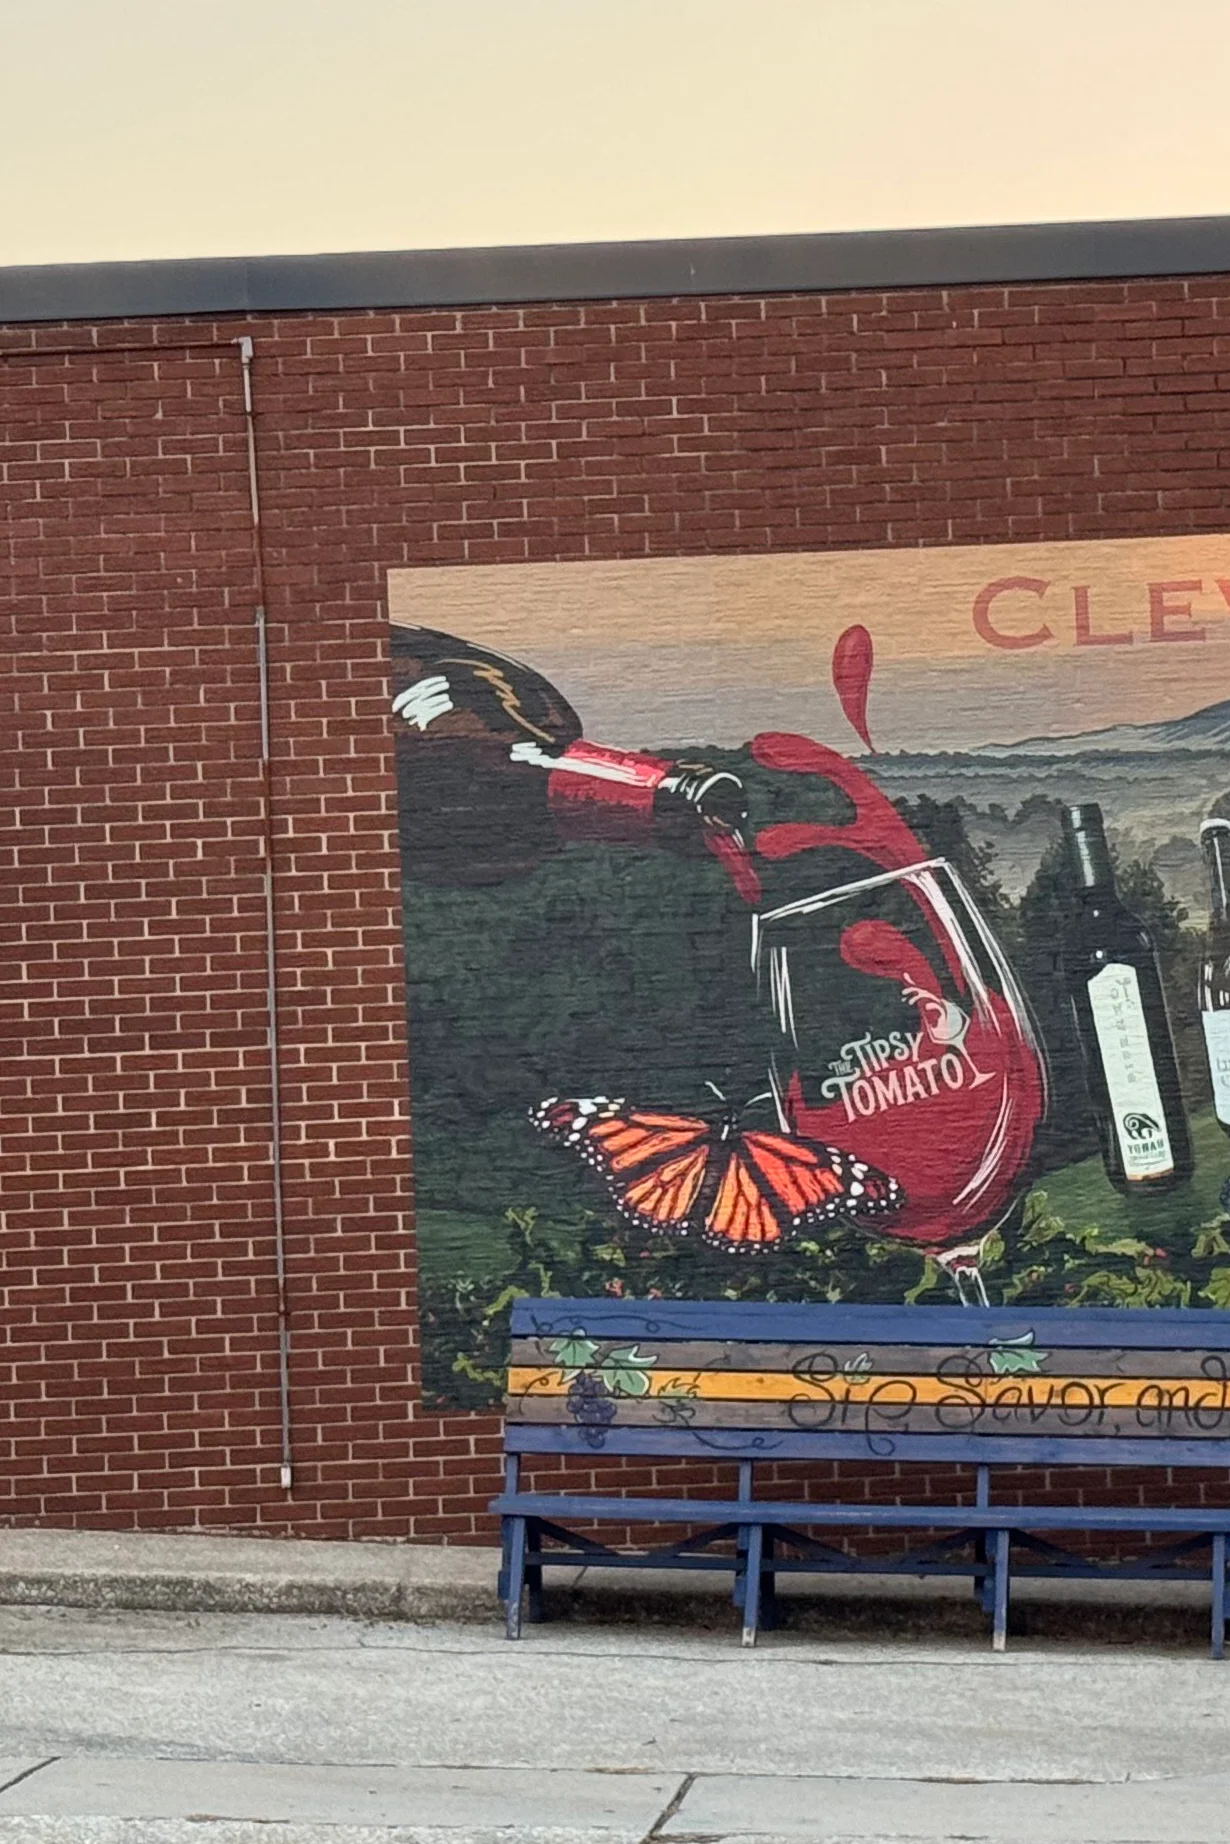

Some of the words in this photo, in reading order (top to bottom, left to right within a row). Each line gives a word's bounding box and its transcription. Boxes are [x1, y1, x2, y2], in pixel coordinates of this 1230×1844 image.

[820, 1052, 963, 1122] TOMATO
[840, 1031, 924, 1077] TIPSY
[934, 1354, 1122, 1435] Savor,
[1135, 1355, 1228, 1430] and
